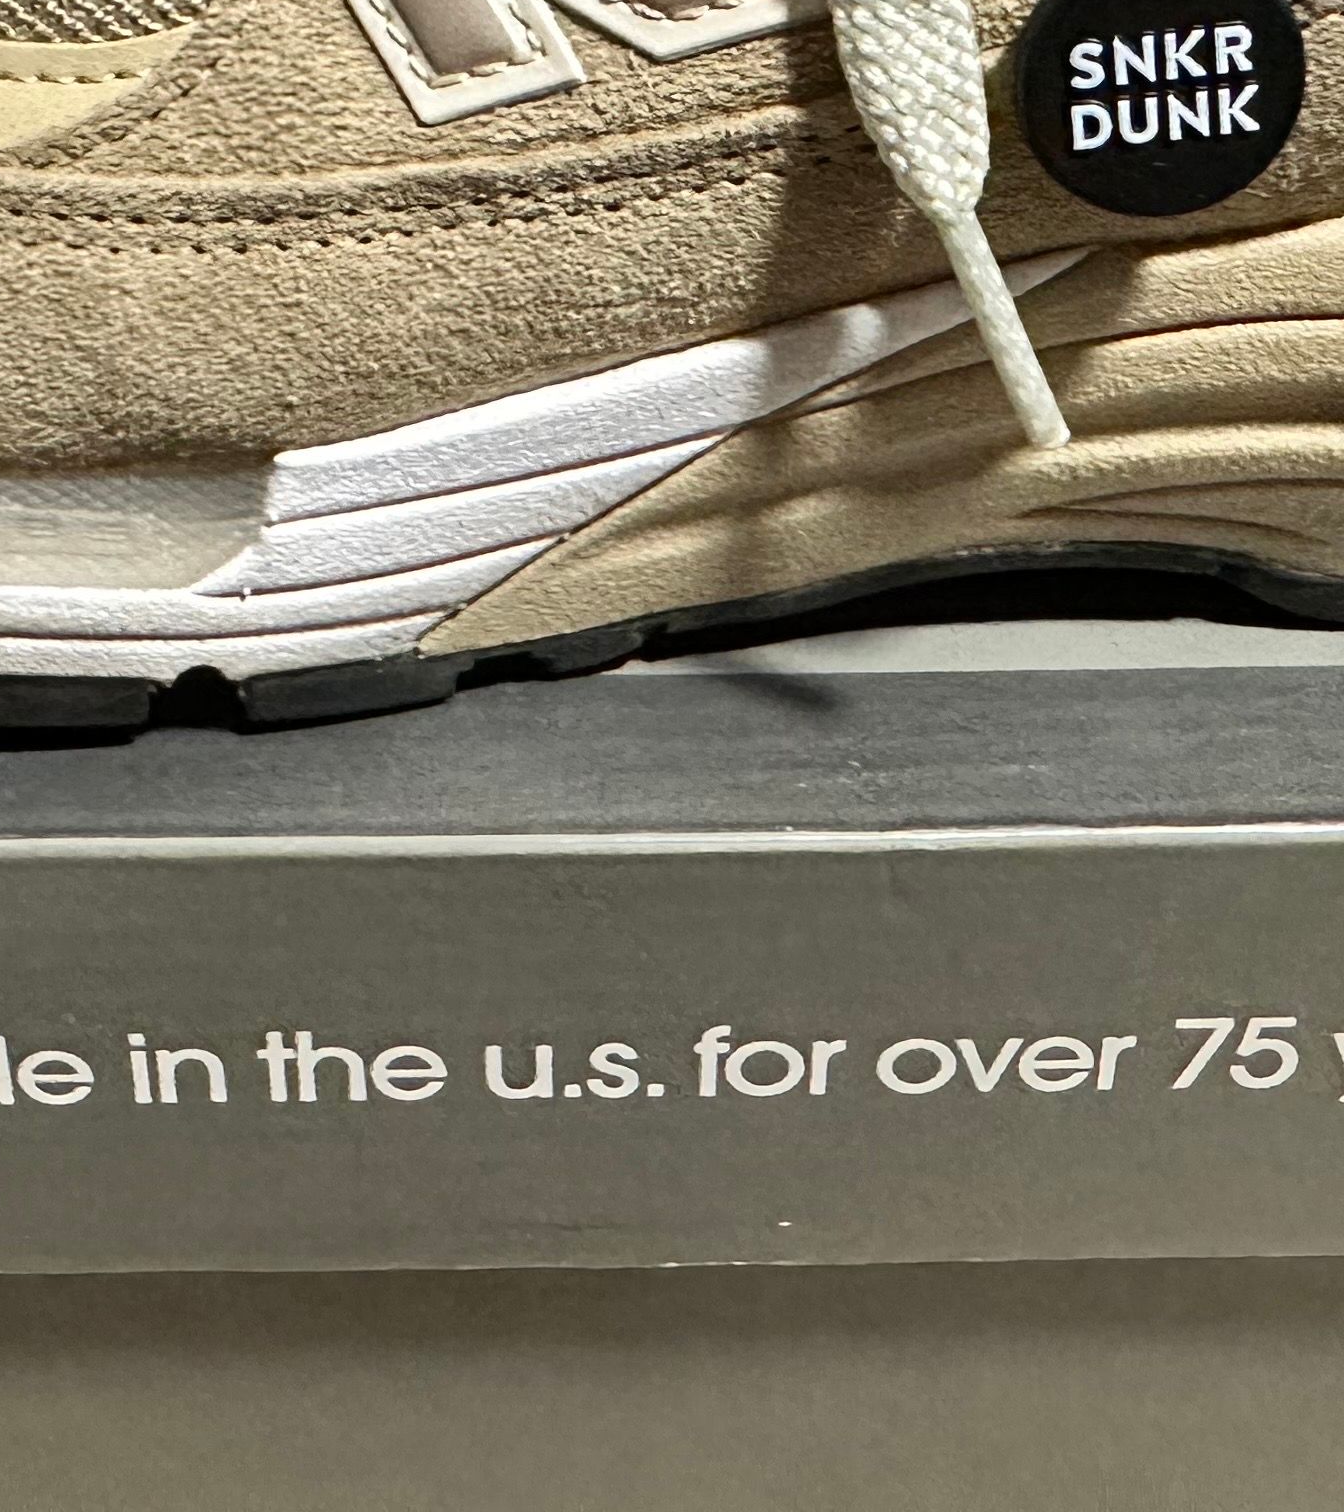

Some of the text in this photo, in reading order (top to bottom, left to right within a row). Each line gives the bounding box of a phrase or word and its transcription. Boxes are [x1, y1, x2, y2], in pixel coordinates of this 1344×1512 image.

[1069, 22, 1253, 89] SNKR
[1070, 81, 1261, 151] DUNK
[127, 1031, 228, 1105] in
[256, 1030, 449, 1103] the
[485, 1040, 666, 1100] u.s.
[694, 1025, 847, 1097] for
[875, 1033, 1137, 1095] over
[1171, 1016, 1299, 1089] 75
